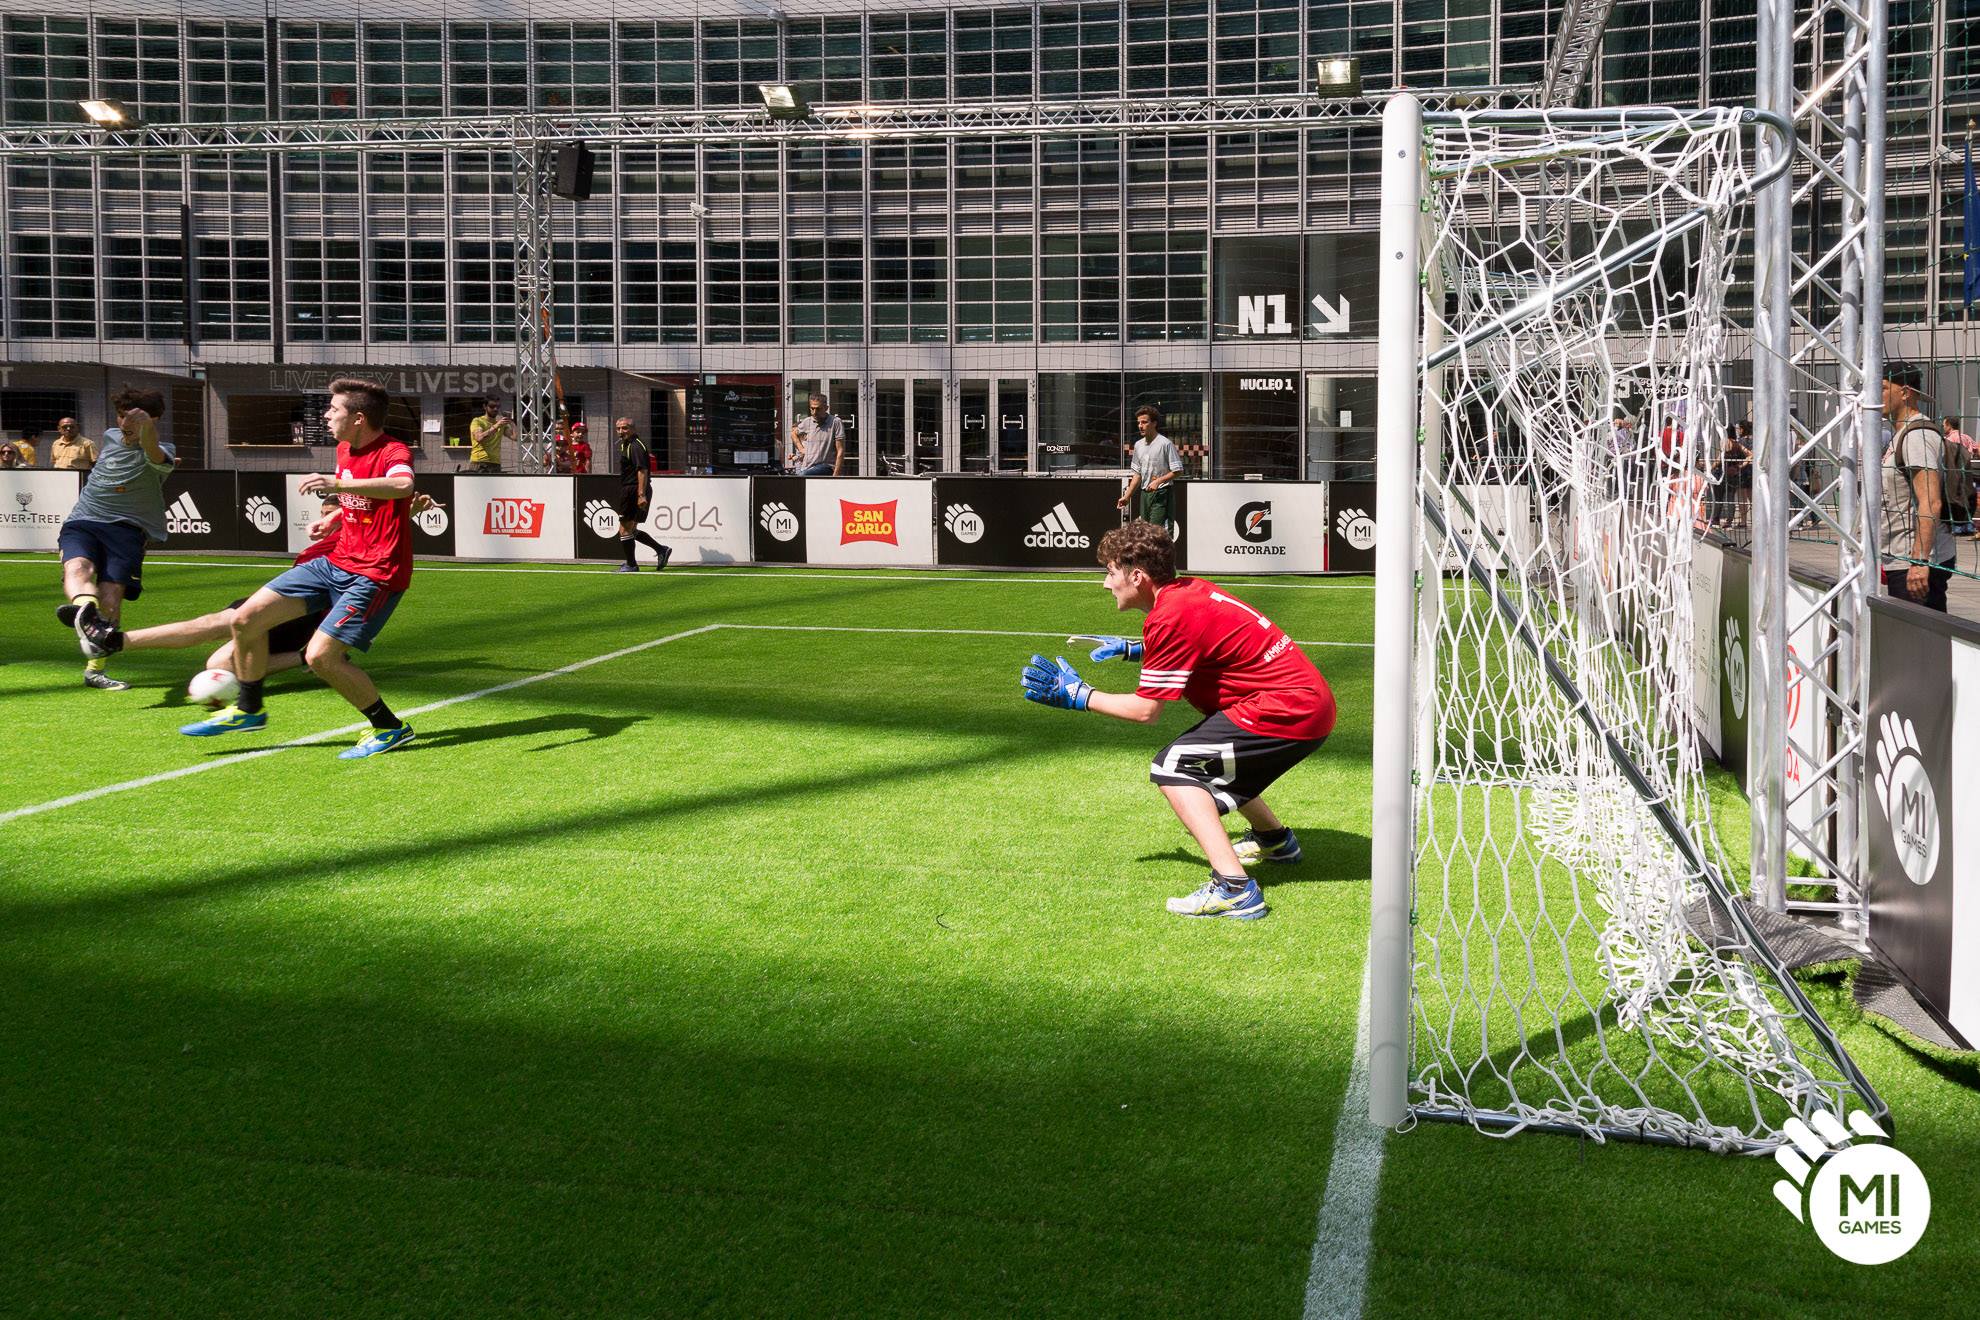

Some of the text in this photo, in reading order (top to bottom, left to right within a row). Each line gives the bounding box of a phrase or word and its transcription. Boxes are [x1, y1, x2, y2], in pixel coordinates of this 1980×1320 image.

[1238, 294, 1292, 334] N1
[1240, 378, 1293, 390] NUCLEO 1
[260, 511, 274, 521] MI
[426, 514, 440, 524] MI
[491, 500, 533, 529] RDS
[853, 510, 884, 522] SAN
[166, 518, 211, 534] didas
[599, 516, 613, 526] MI
[776, 518, 791, 529] MI
[961, 520, 976, 531] MI
[845, 523, 893, 535] CARLO
[1355, 525, 1371, 537] MI
[1023, 531, 1090, 548] adidas
[1224, 545, 1286, 555] GATORADE
[333, 605, 360, 628] 7
[1209, 591, 1272, 630] 1
[1901, 782, 1926, 839] MI
[1902, 830, 1928, 858] GAMES
